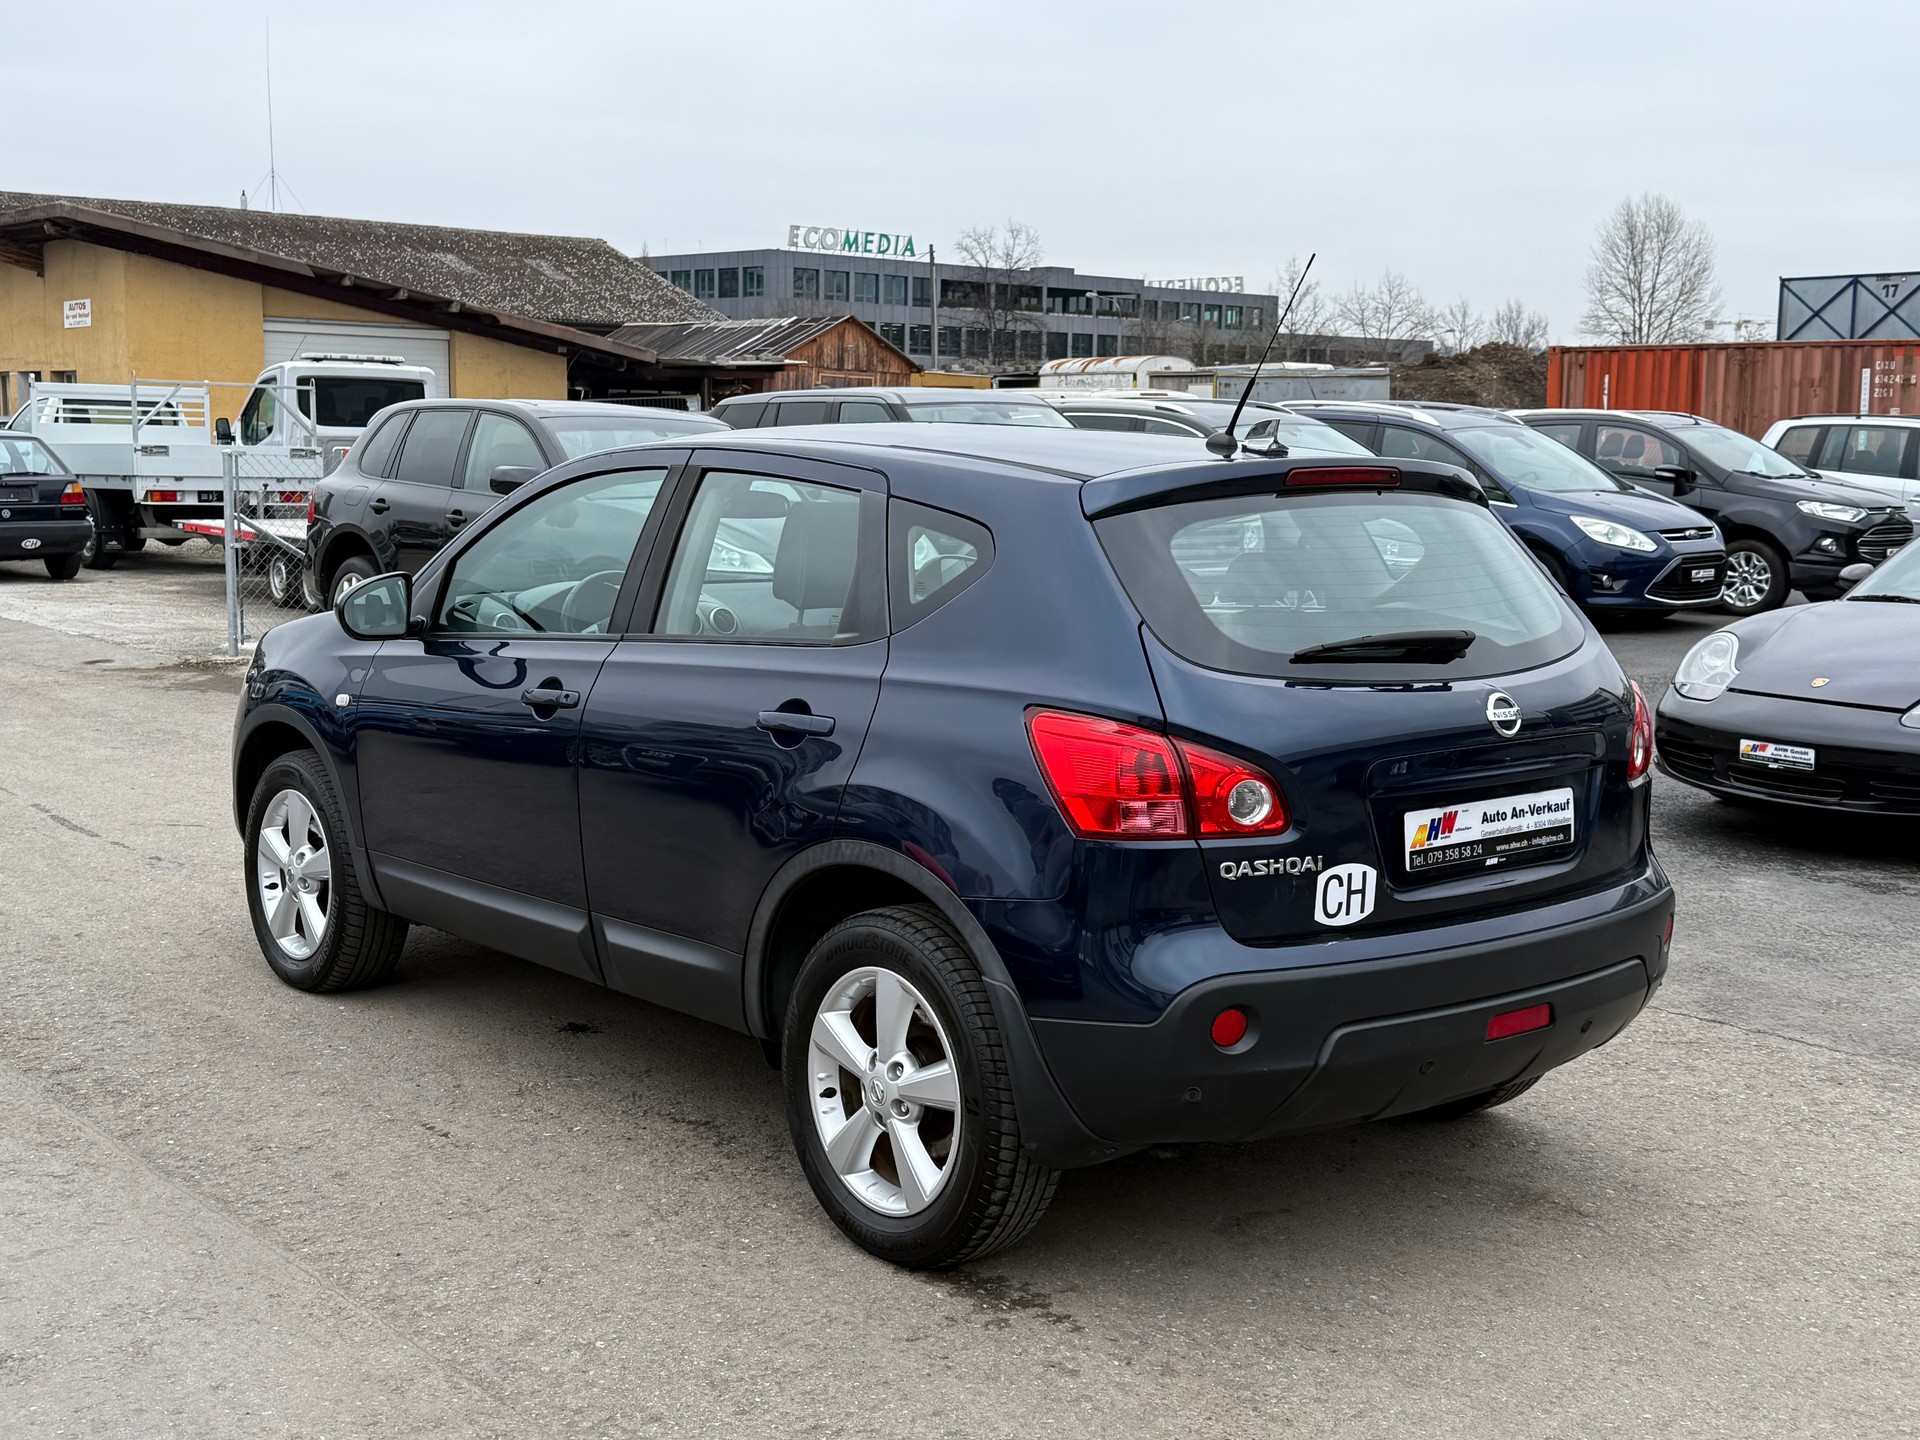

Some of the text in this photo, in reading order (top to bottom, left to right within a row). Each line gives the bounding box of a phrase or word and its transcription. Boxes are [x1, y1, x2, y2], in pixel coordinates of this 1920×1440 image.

[787, 225, 916, 257] ECOMEDIA
[1882, 284, 1900, 298] 17
[69, 302, 86, 312] AUTOS
[1481, 798, 1570, 824] Auto An-Verkauf
[1547, 817, 1571, 826] Wallisellen
[1410, 810, 1459, 849] AHW
[1496, 840, 1528, 851] www.ahw.ch
[1532, 833, 1564, 845] info@ahw.ch
[1412, 844, 1482, 866] Tel. 079 358 58 24
[1322, 870, 1367, 919] CH
[826, 931, 915, 967] BRIDGESTONE
